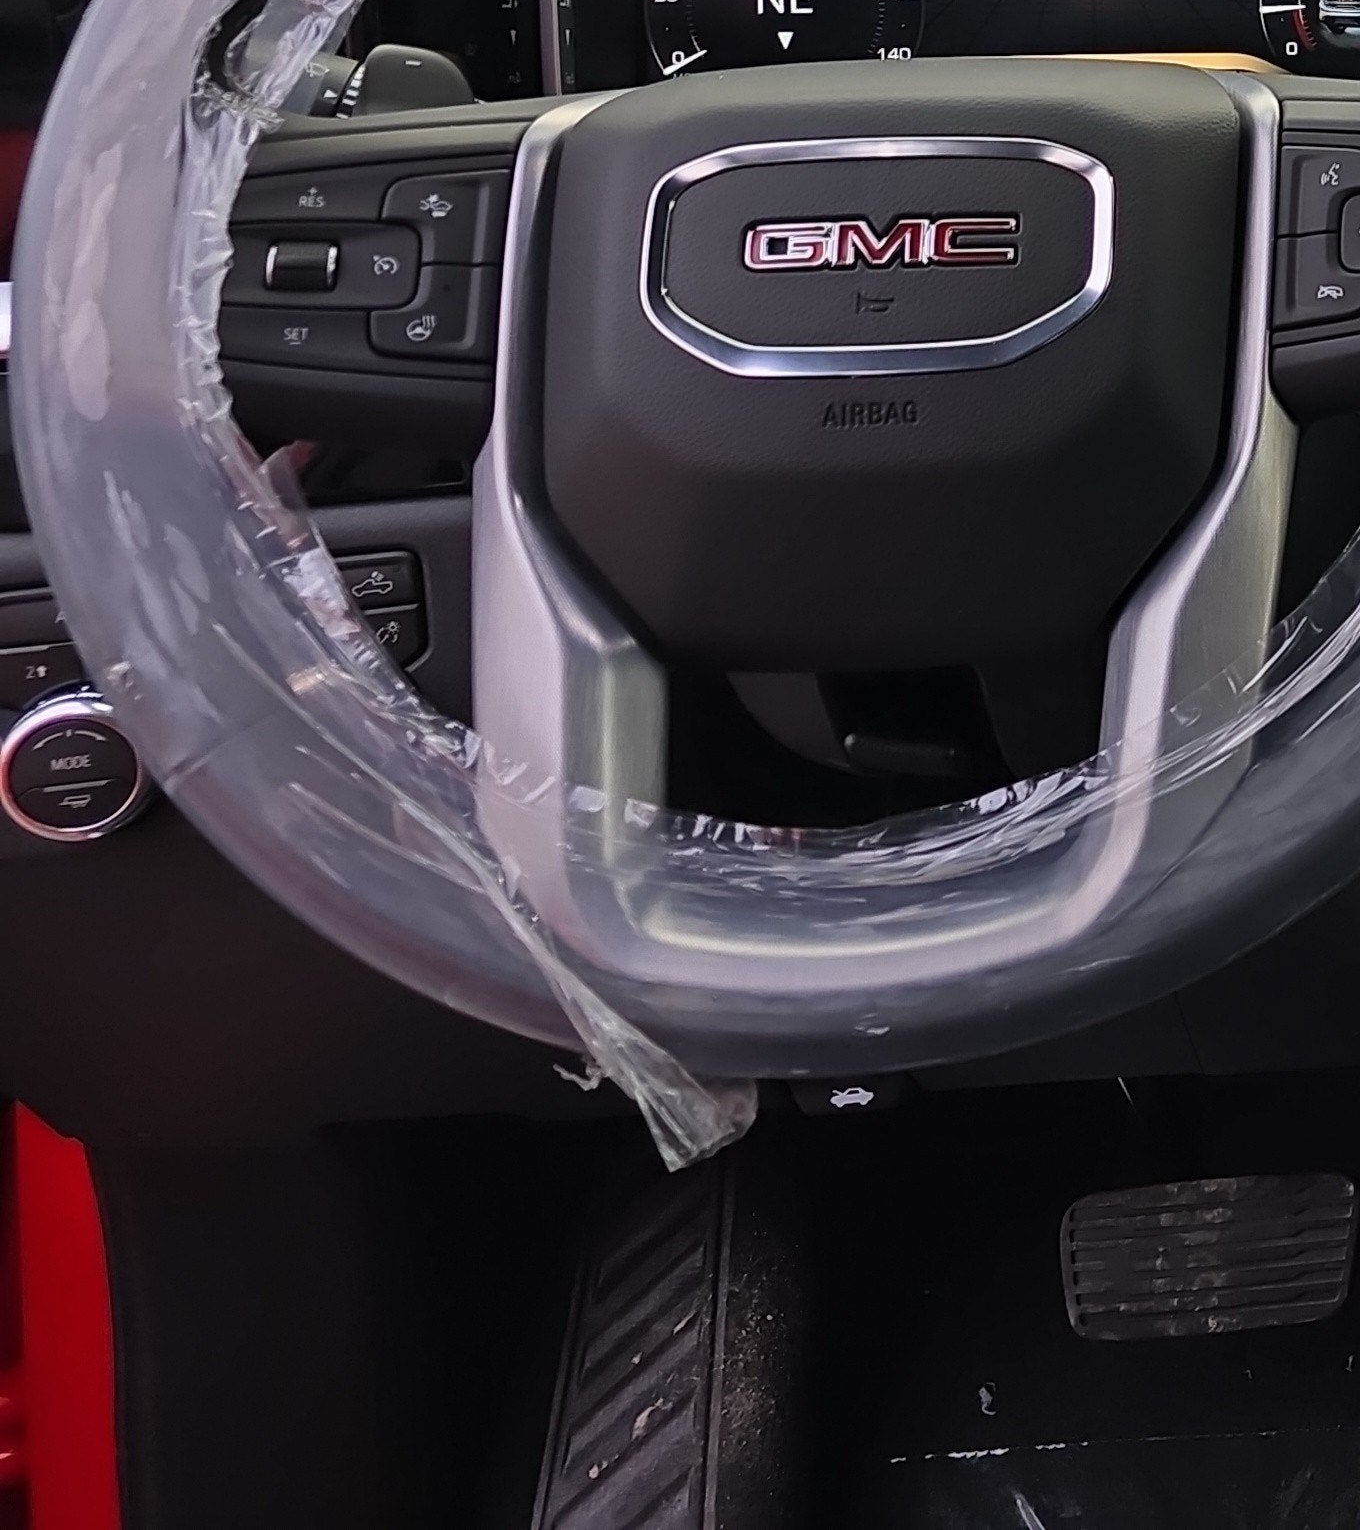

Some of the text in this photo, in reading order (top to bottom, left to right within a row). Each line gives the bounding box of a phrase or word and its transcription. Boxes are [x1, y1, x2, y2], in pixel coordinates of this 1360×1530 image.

[877, 47, 912, 62] 140
[1286, 42, 1298, 56] 0
[299, 196, 325, 208] RES
[743, 218, 1018, 271] GMC
[283, 327, 309, 341] SET
[821, 401, 919, 430] AIRBAG
[50, 754, 92, 771] MODE
